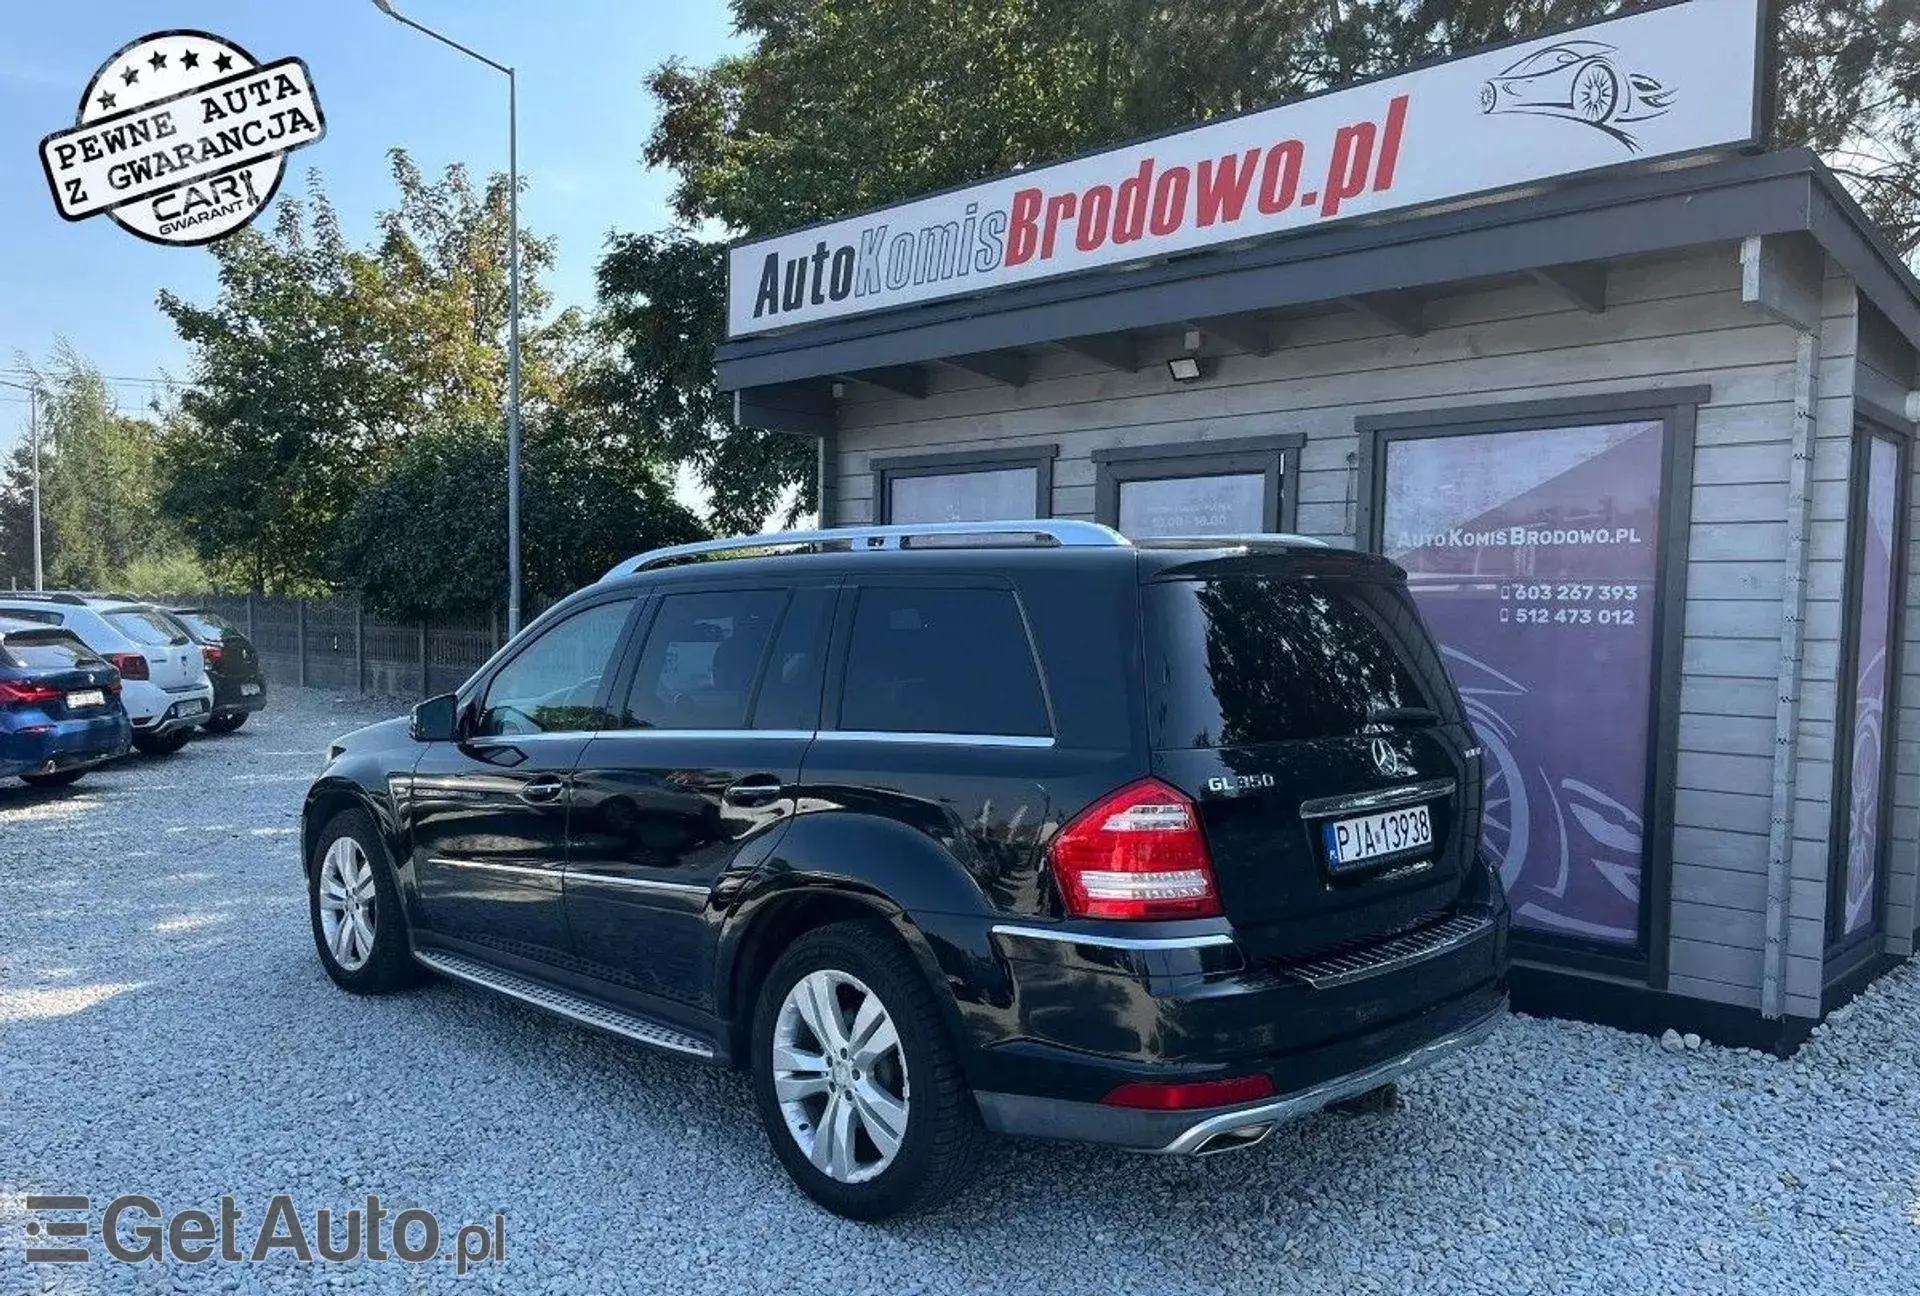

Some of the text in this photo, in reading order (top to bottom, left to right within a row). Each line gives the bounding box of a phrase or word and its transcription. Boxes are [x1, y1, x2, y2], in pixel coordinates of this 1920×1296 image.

[753, 95, 1410, 319] AutoKomisBrodowo.pl
[1515, 584, 1638, 601] 603 267 393
[1516, 608, 1635, 625] 512 473 012
[1208, 774, 1275, 791] GL 350
[1336, 810, 1429, 860] PJA 13938
